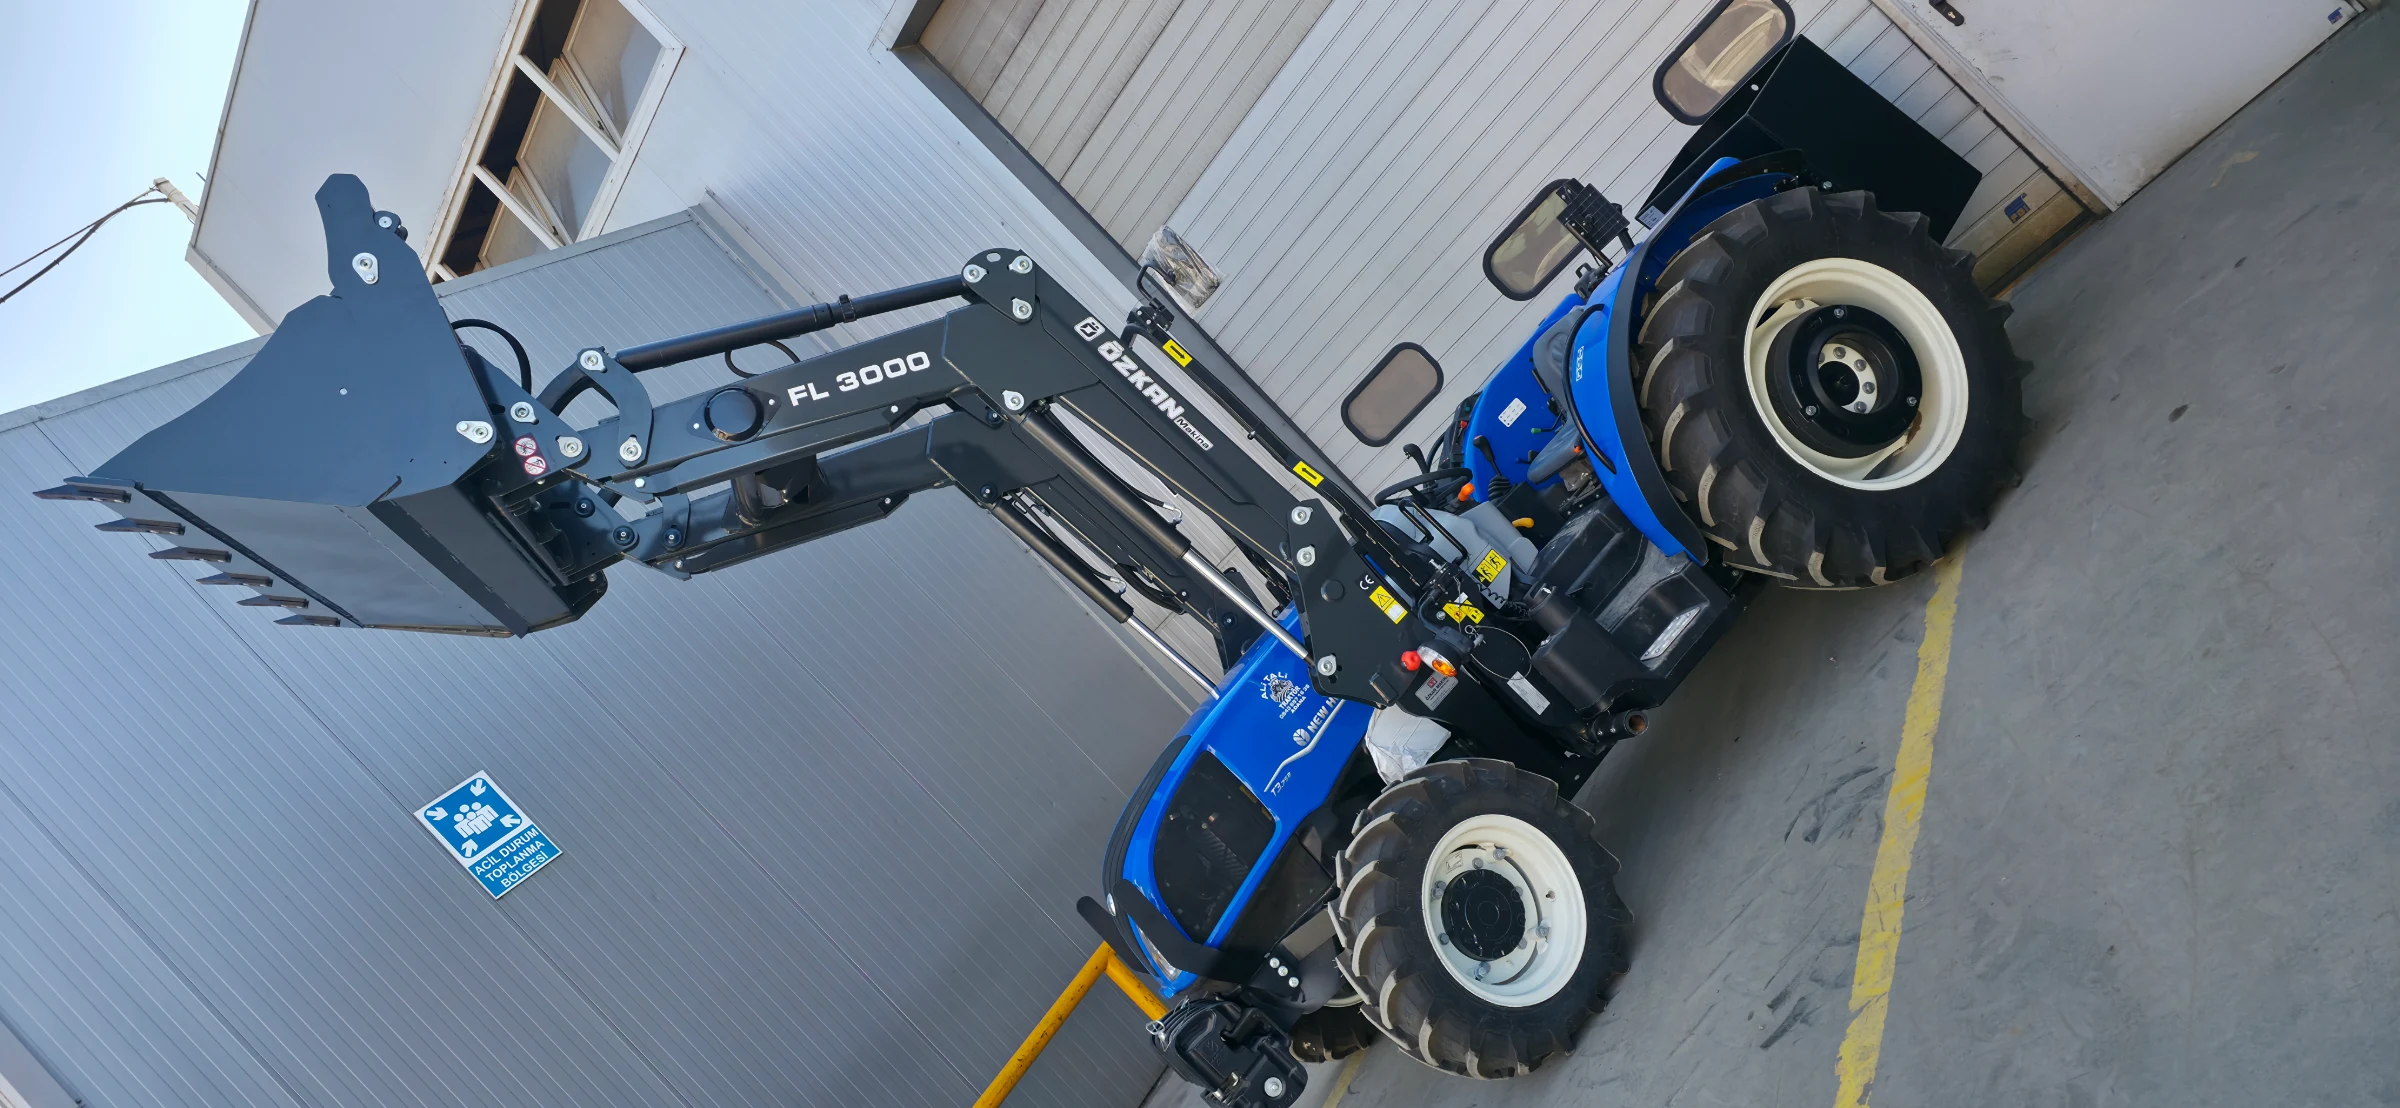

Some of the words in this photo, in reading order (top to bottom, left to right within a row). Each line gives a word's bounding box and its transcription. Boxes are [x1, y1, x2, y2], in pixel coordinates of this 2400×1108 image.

[787, 382, 830, 407] FL
[836, 351, 931, 392] 3000
[1097, 340, 1185, 420] ÖZKAN
[1176, 418, 1210, 449] Makina
[1290, 695, 1307, 714] ADANA
[1307, 705, 1329, 733] NEW
[475, 855, 501, 876] ACİL
[499, 827, 540, 858] DURUM
[485, 840, 545, 882] TOPLANMA
[500, 850, 549, 888] BÖLGESİ
